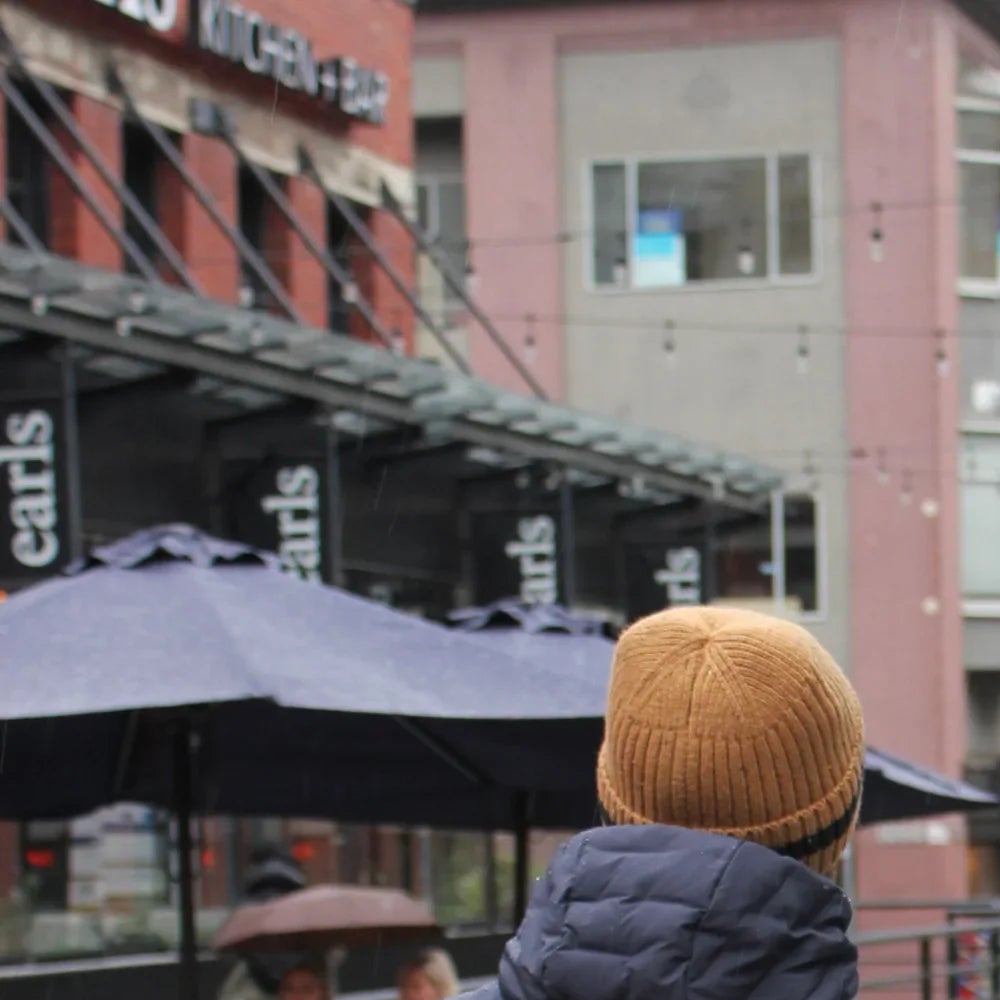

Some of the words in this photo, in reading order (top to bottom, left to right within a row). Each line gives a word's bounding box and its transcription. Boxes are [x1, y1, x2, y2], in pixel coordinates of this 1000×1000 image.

[199, 0, 319, 95] KITCHEN
[339, 56, 389, 123] BAR
[0, 409, 58, 567] earls
[505, 515, 557, 604] arls
[654, 546, 700, 606] rls
